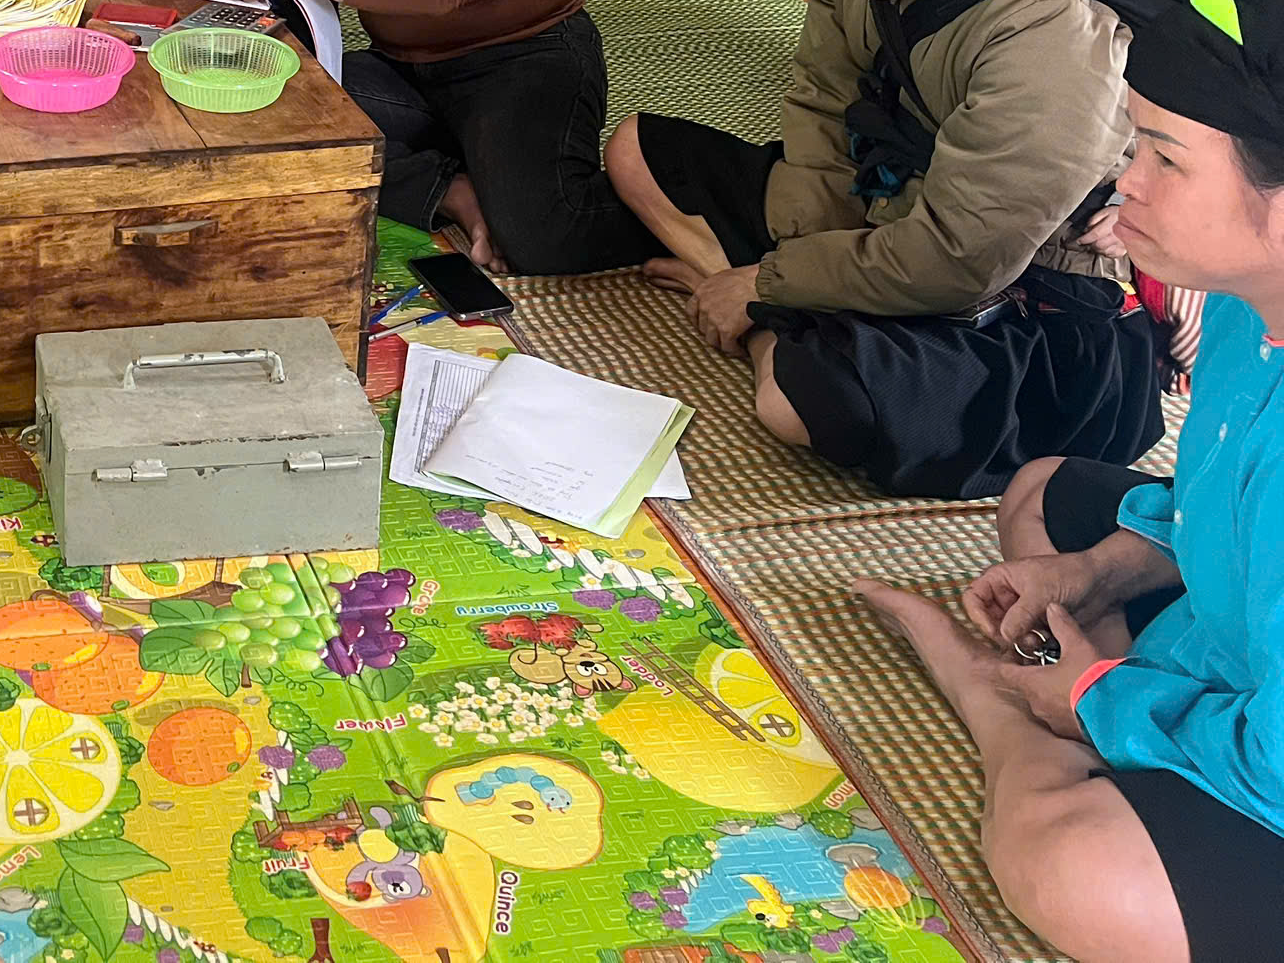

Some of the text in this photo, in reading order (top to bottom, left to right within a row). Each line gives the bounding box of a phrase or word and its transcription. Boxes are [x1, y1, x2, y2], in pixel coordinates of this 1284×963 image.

[456, 602, 559, 616] Strawberry
[621, 655, 674, 698] Ladder
[334, 713, 406, 733] Flower
[263, 856, 312, 875] Fruit
[495, 869, 519, 934] Quince
